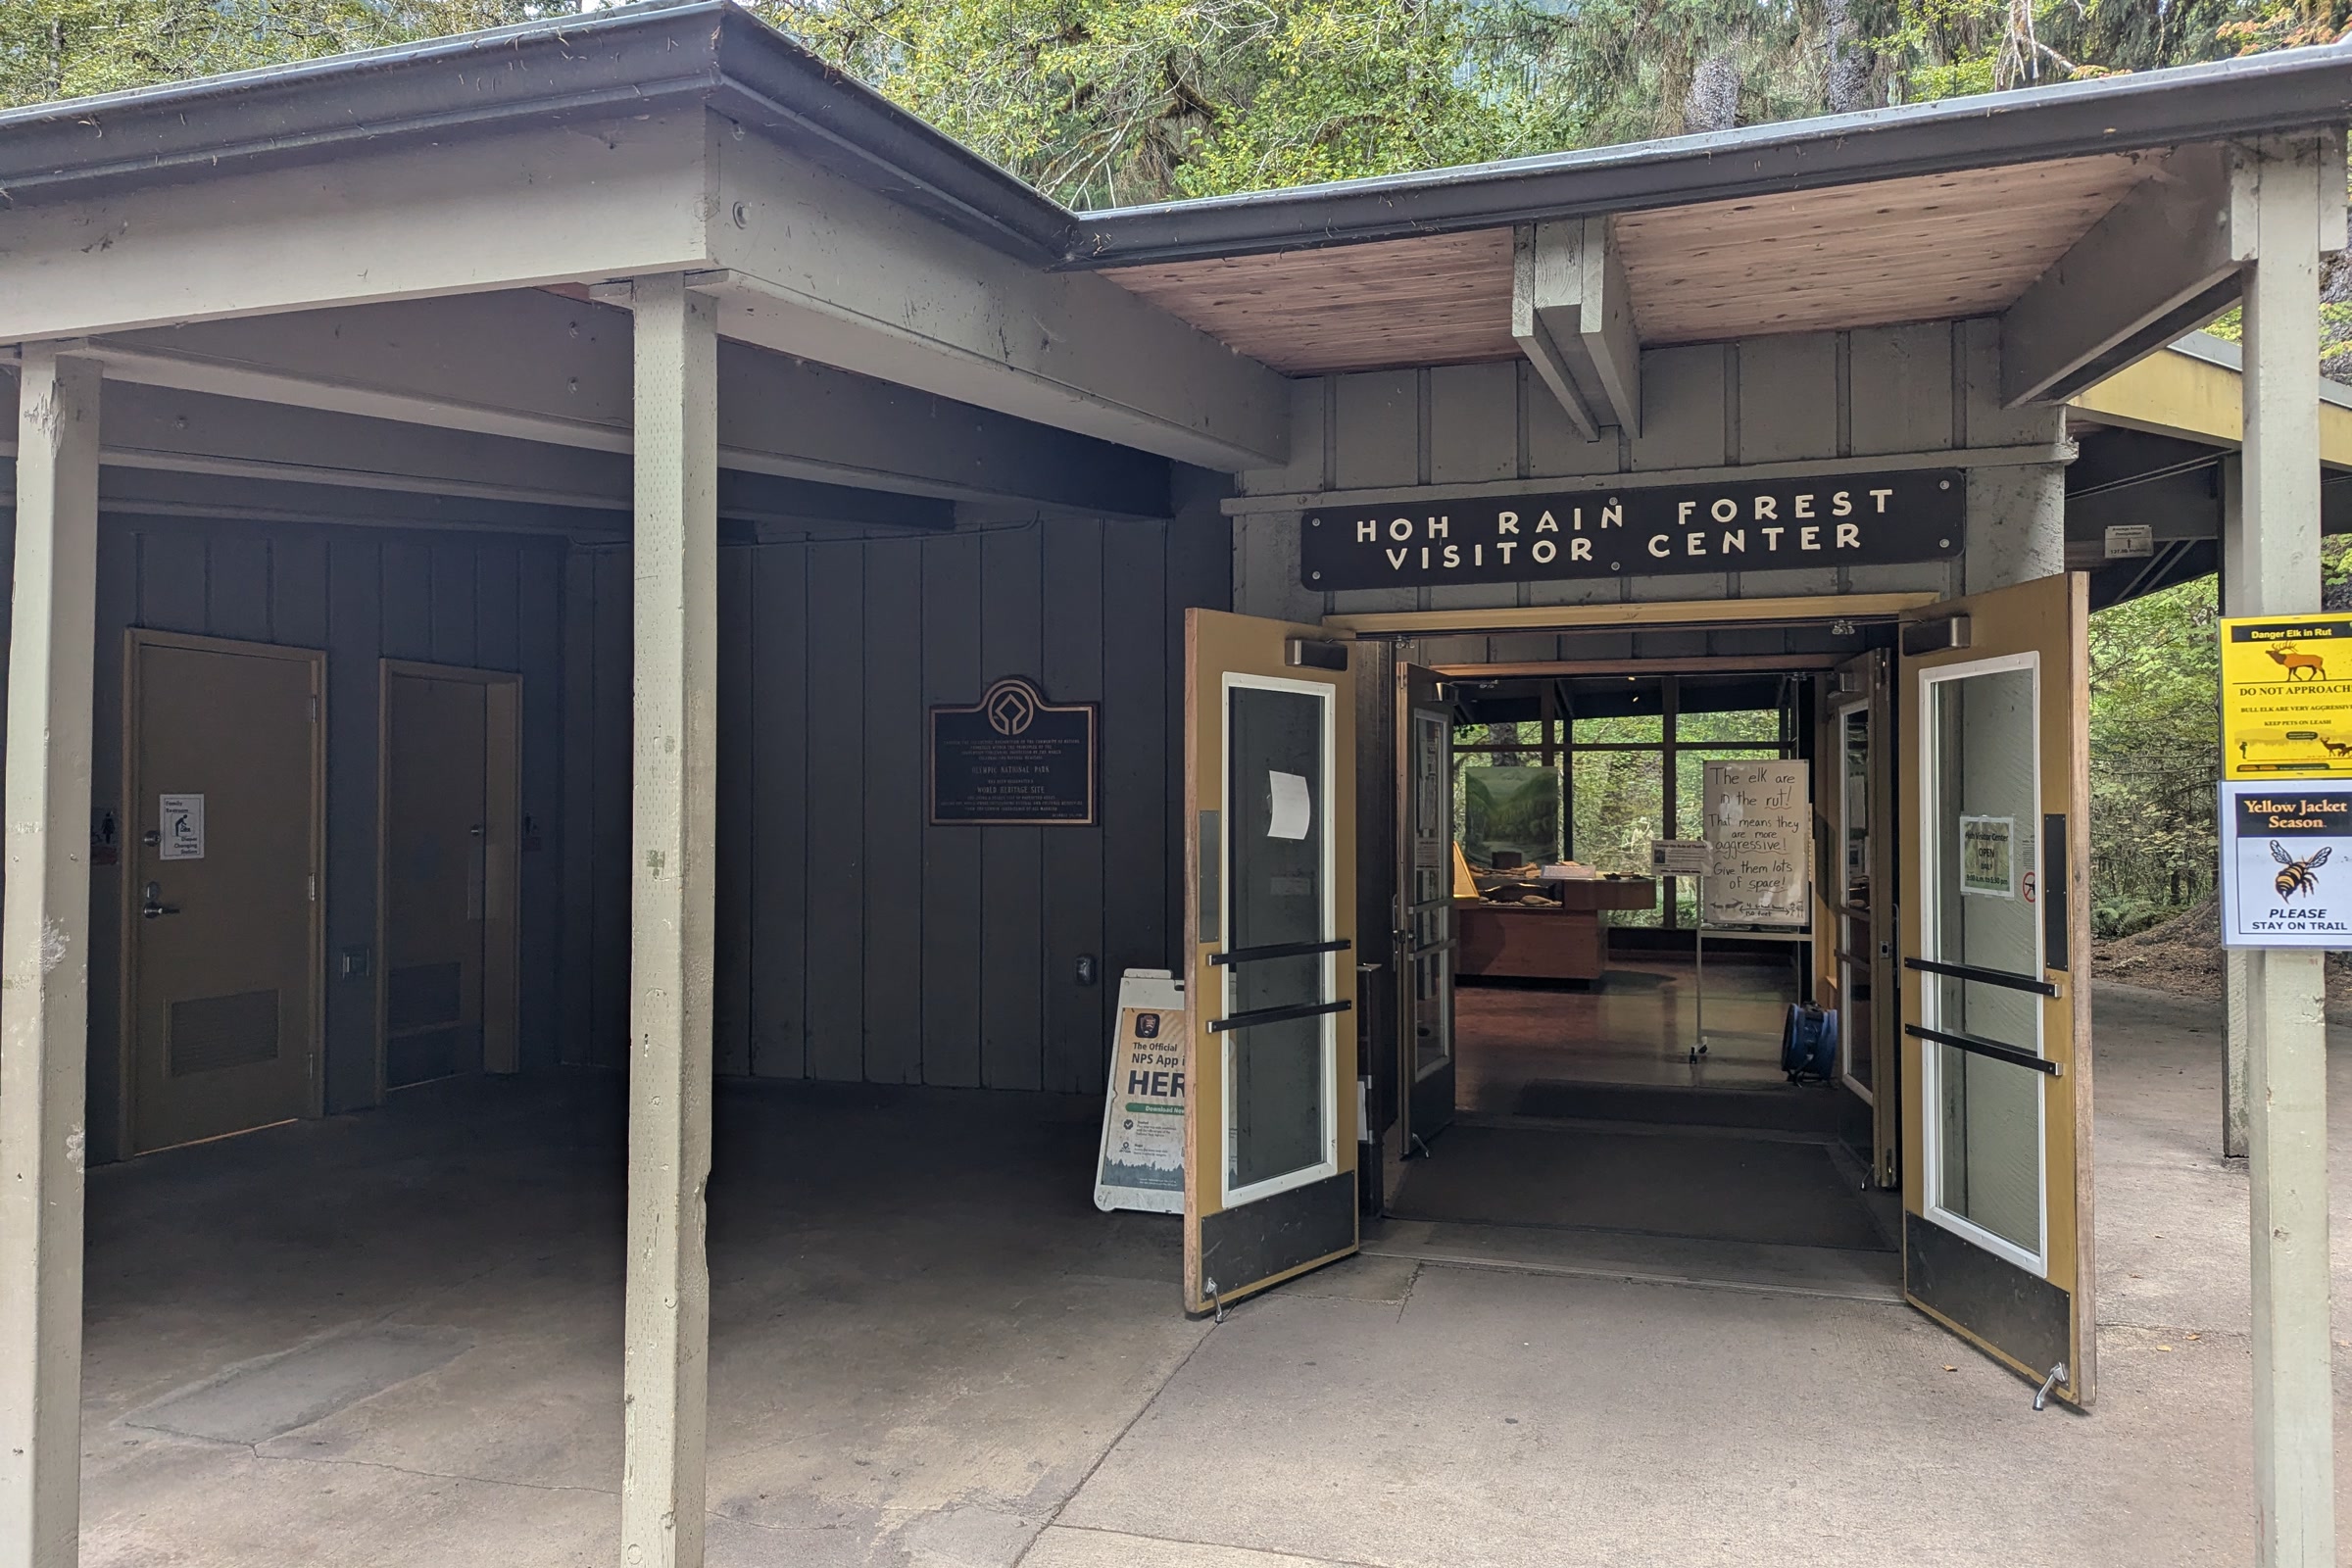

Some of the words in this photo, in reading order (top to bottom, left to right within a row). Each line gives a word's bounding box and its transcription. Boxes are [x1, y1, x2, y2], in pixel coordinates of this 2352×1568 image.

[1356, 515, 1449, 542] HOH
[1499, 506, 1623, 535] RAIN
[1678, 489, 1893, 525] FOREST
[1386, 537, 1593, 570] VISITOR
[1648, 522, 1861, 559] CENTER
[2251, 630, 2284, 640] Danger
[2286, 629, 2301, 638] Elk
[2239, 687, 2257, 696] DO
[2259, 686, 2283, 696] NOT
[1709, 767, 1740, 785] The
[1748, 767, 1768, 783] elk
[1775, 773, 1795, 784] are
[1720, 792, 1730, 805] in
[1737, 791, 1757, 806] the
[1766, 786, 1791, 807] rut!
[2243, 800, 2296, 813] Yellow
[2300, 800, 2348, 815] Jacket
[1708, 813, 1731, 827] That
[1739, 818, 1772, 827] means
[1777, 815, 1799, 833] they
[2268, 815, 2324, 828] Season
[1731, 830, 1745, 839] are
[1754, 830, 1777, 839] more
[1976, 832, 1991, 841] Visitor
[1991, 833, 2008, 842] Center
[1715, 840, 1787, 859] aggressive!
[1979, 848, 1994, 858] OPEN
[1713, 862, 1735, 875] Give
[1740, 859, 1768, 873] them
[1772, 859, 1793, 872] lots
[1730, 876, 1742, 889] of
[1748, 877, 1786, 893] space!
[2269, 908, 2328, 919] PLEASE
[2252, 921, 2283, 930] STAY
[2287, 921, 2306, 930] ON
[2310, 921, 2348, 930] TRAIL
[1133, 1042, 1147, 1051] The
[1150, 1043, 1177, 1052] Official
[1131, 1053, 1153, 1064] NPS
[1156, 1055, 1179, 1068] App
[1182, 1055, 1185, 1066] i
[1127, 1070, 1185, 1098] HER
